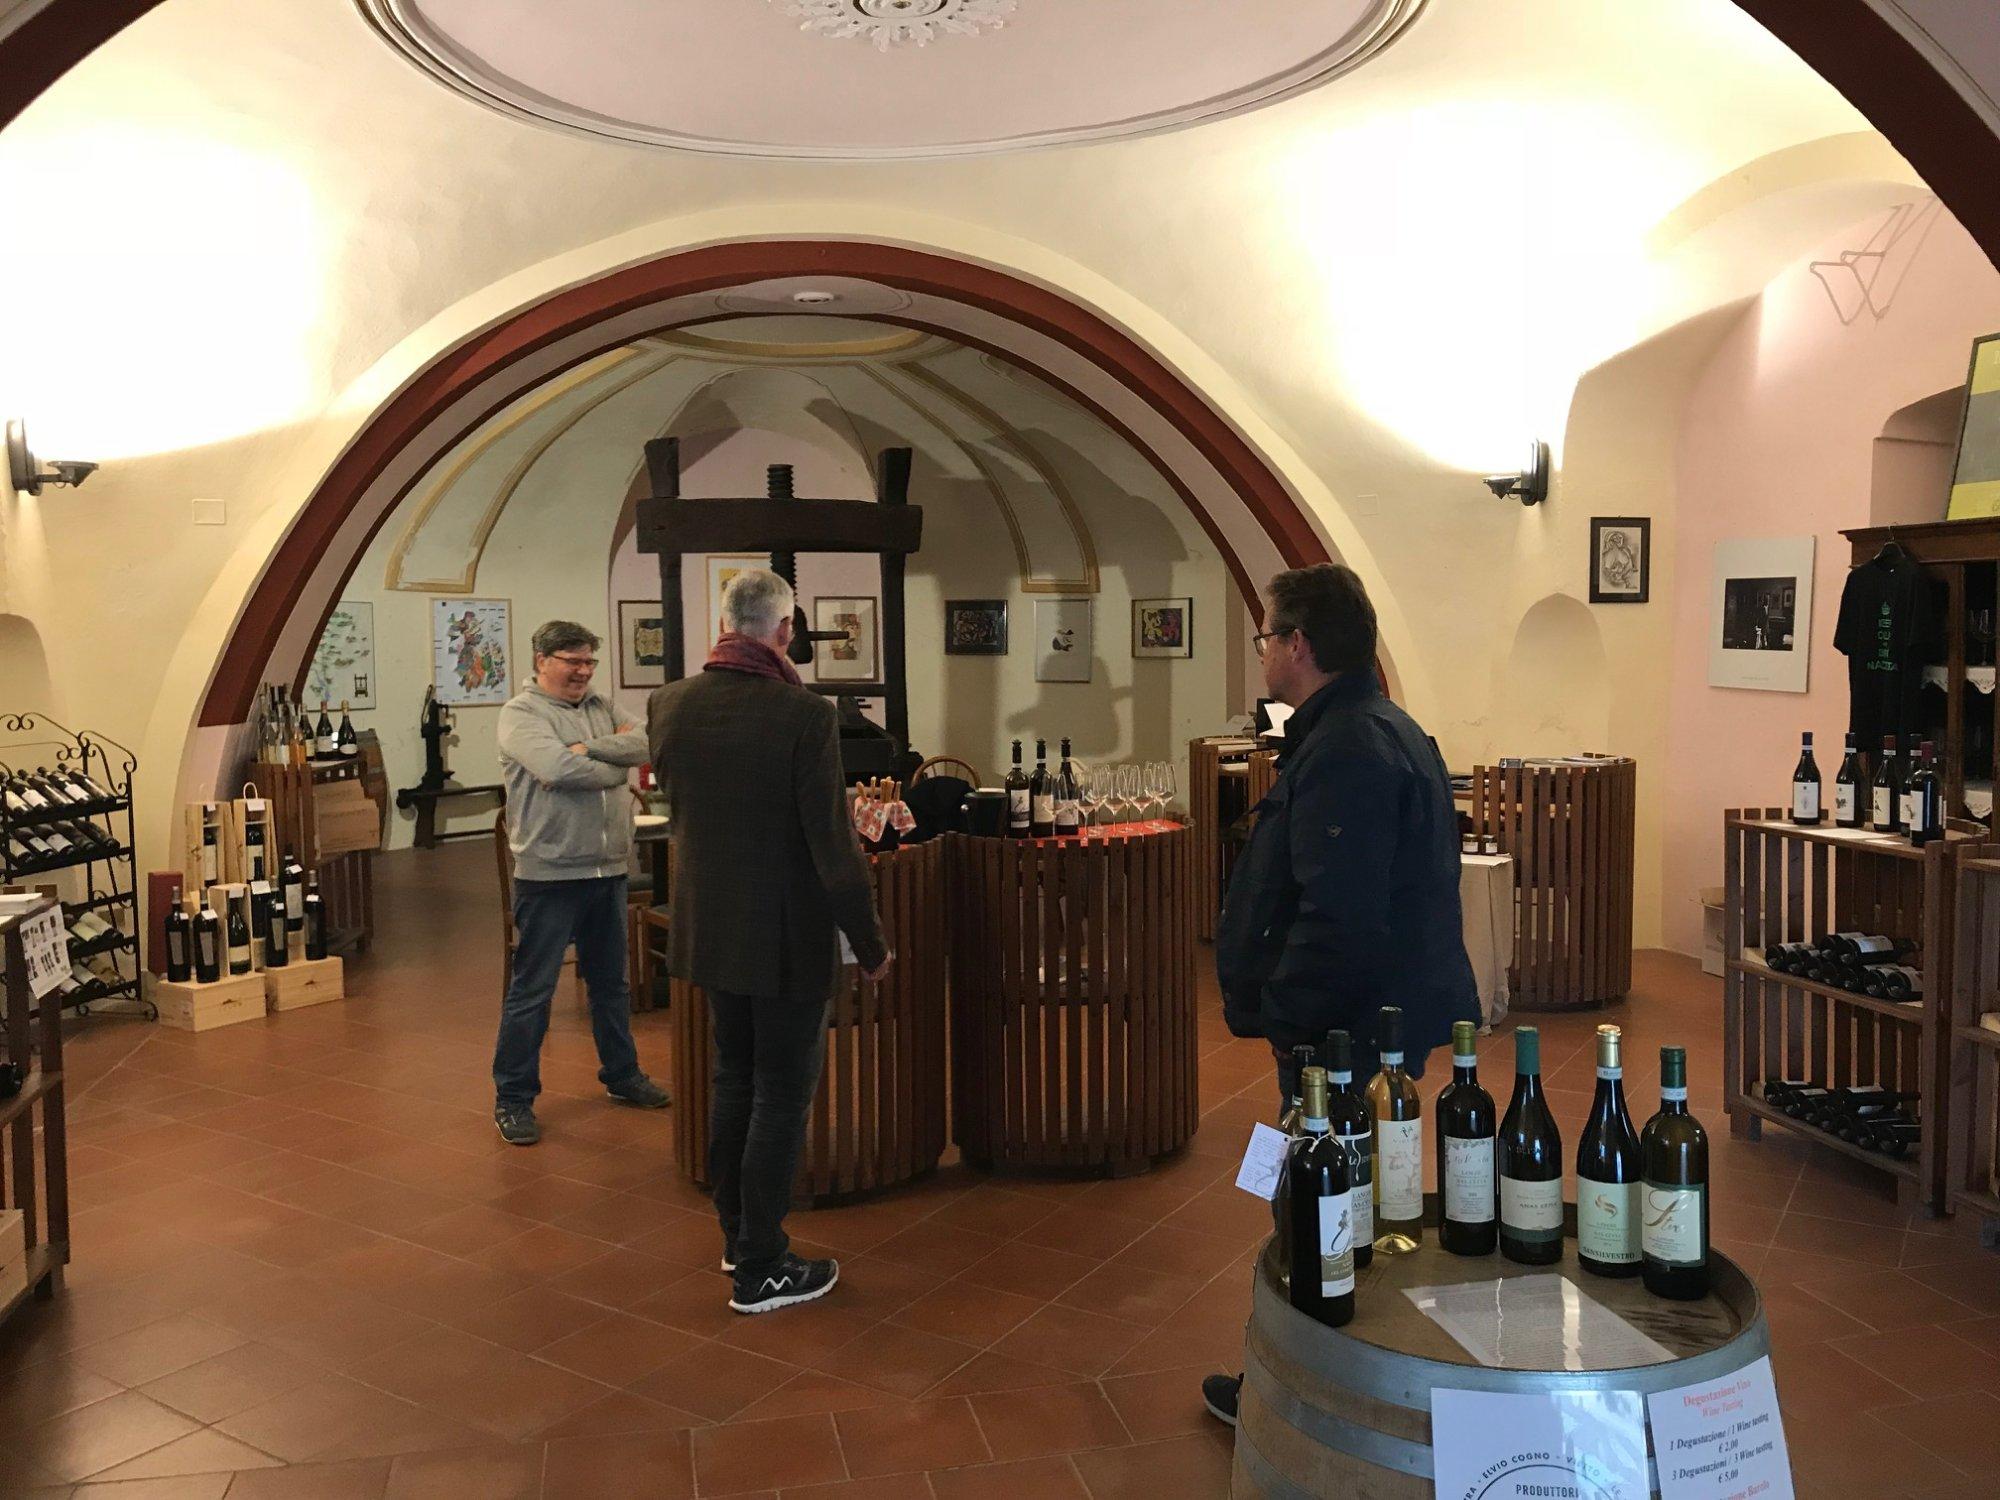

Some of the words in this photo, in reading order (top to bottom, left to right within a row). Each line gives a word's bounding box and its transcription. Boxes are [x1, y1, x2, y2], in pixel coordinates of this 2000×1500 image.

[1683, 1387, 1736, 1407] Degustazione
[1702, 1407, 1721, 1417] Wine
[1677, 1430, 1727, 1449] Degustazione
[1737, 1419, 1752, 1432] Wine
[1752, 1412, 1769, 1427] tasting
[1724, 1439, 1739, 1452] 2,00
[1482, 1459, 1508, 1480] ELVIO
[1511, 1452, 1551, 1464] COGNO
[1672, 1470, 1677, 1481] 3
[1679, 1459, 1727, 1479] Degustazioni
[1739, 1448, 1755, 1461] Wine
[1755, 1440, 1773, 1455] tasting
[1724, 1469, 1739, 1482] 5,00
[1516, 1483, 1579, 1498] PRODUTTORI
